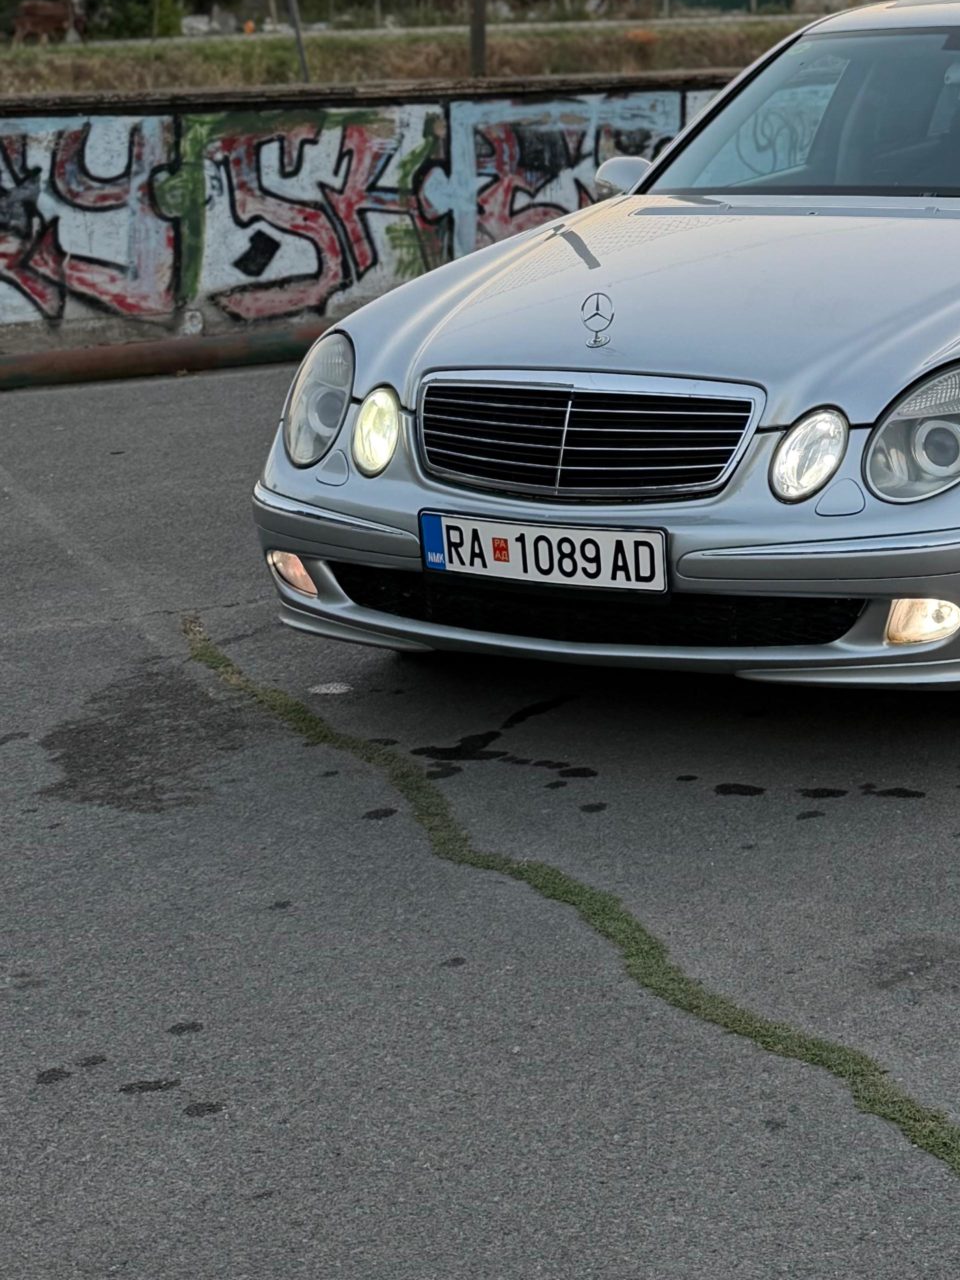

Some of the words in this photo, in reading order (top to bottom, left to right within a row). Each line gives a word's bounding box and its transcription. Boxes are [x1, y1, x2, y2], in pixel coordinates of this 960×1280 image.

[427, 551, 446, 564] NMK
[445, 524, 488, 569] RA
[515, 532, 602, 580] 1089
[610, 539, 656, 583] AD
